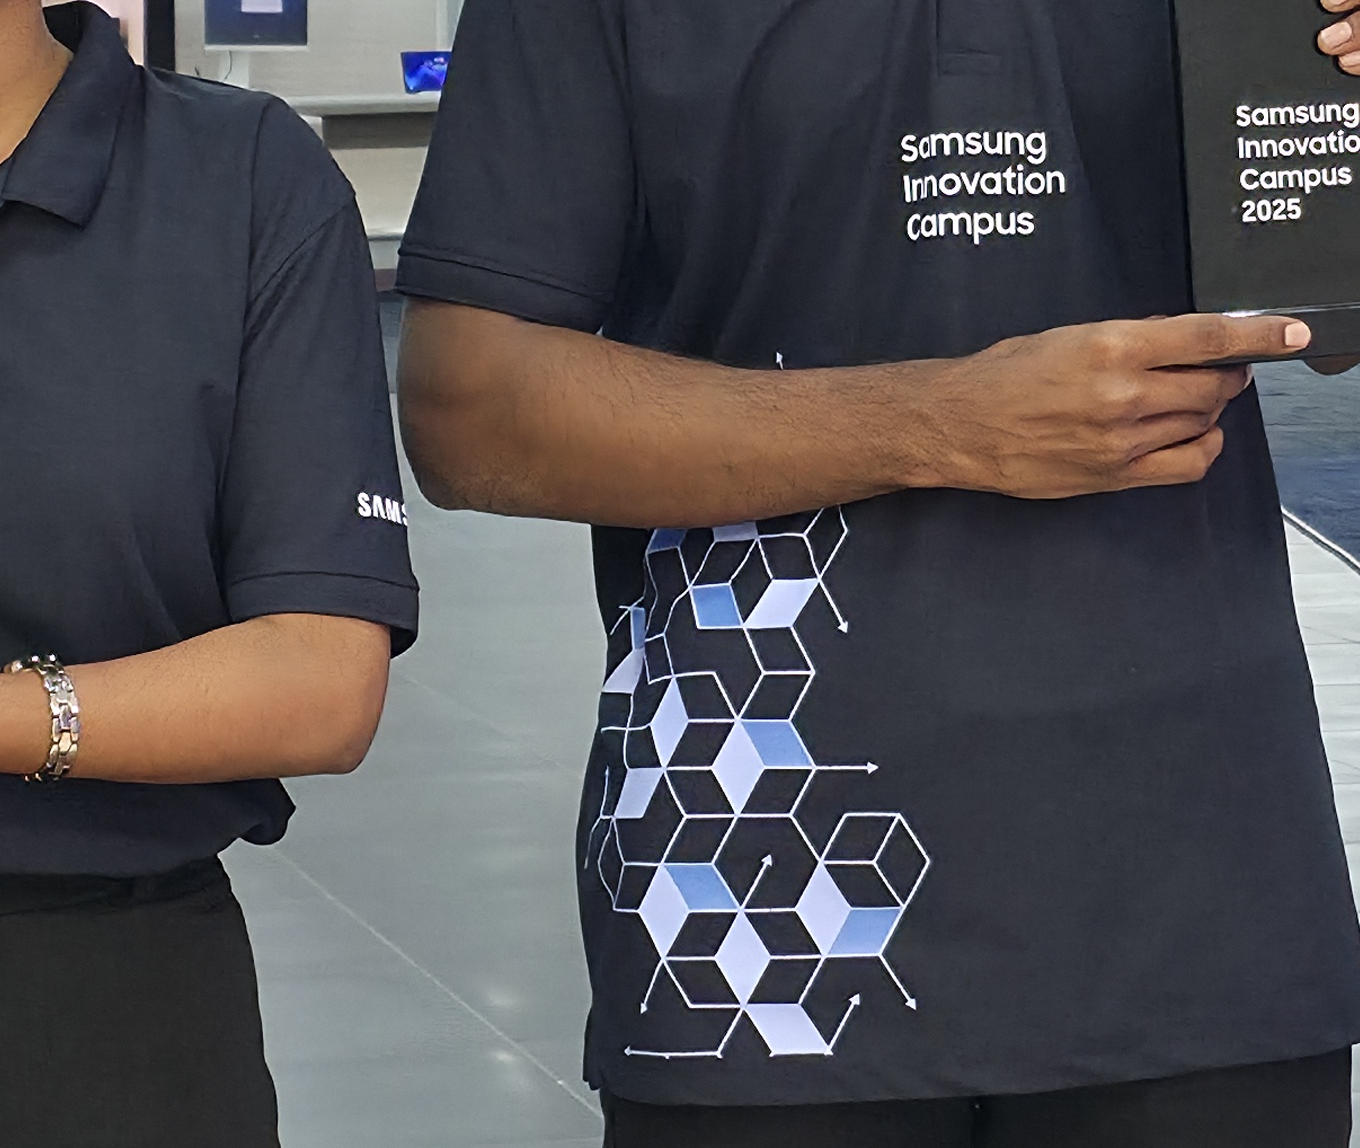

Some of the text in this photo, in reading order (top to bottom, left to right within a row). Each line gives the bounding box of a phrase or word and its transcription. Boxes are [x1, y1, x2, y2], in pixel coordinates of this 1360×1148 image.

[1236, 101, 1360, 128] Samsung
[900, 130, 1047, 166] Samsung
[902, 164, 1066, 204] Innovation
[1239, 166, 1353, 193] Campus
[1241, 198, 1302, 223] 2025
[907, 210, 1036, 245] Campus
